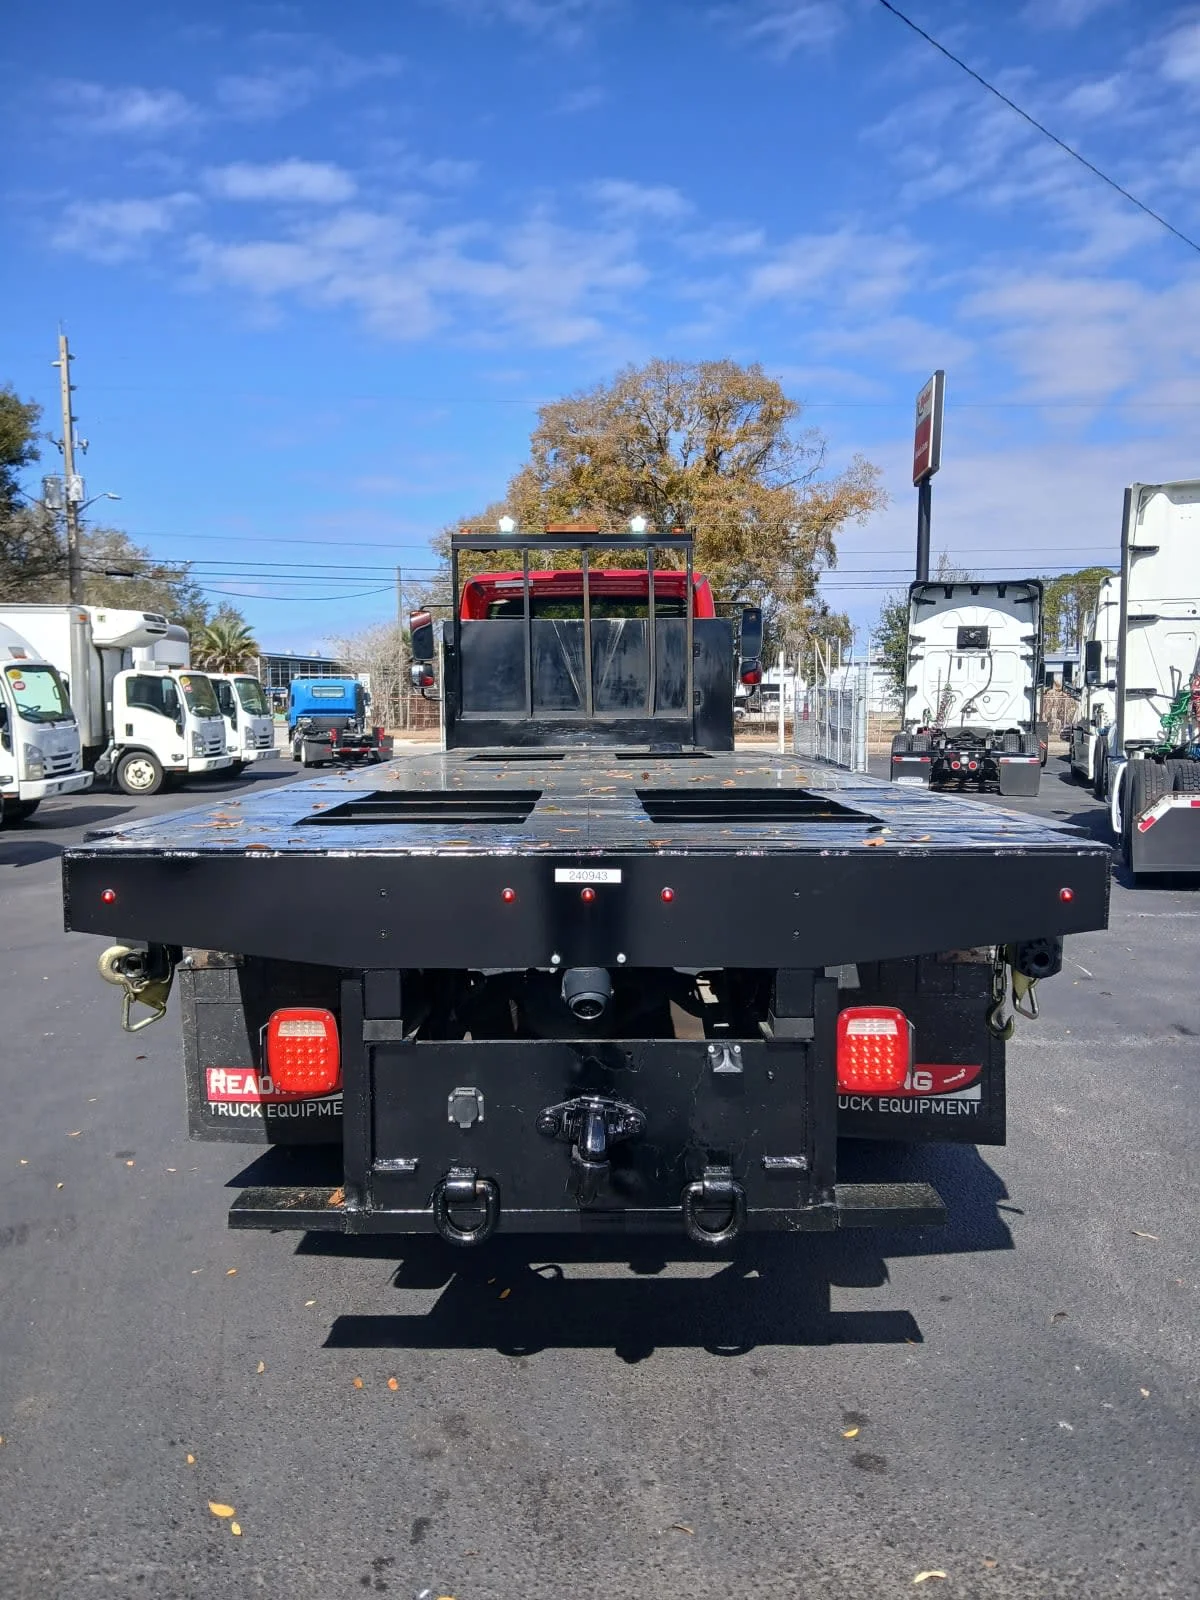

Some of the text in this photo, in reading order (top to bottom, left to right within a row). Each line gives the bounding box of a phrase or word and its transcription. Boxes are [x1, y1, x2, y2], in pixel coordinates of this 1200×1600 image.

[569, 871, 608, 881] 240943
[210, 1069, 281, 1095] READ
[209, 1101, 343, 1118] TRUCK EQUIPME
[838, 1096, 981, 1115] UCK EQUIPMENT
